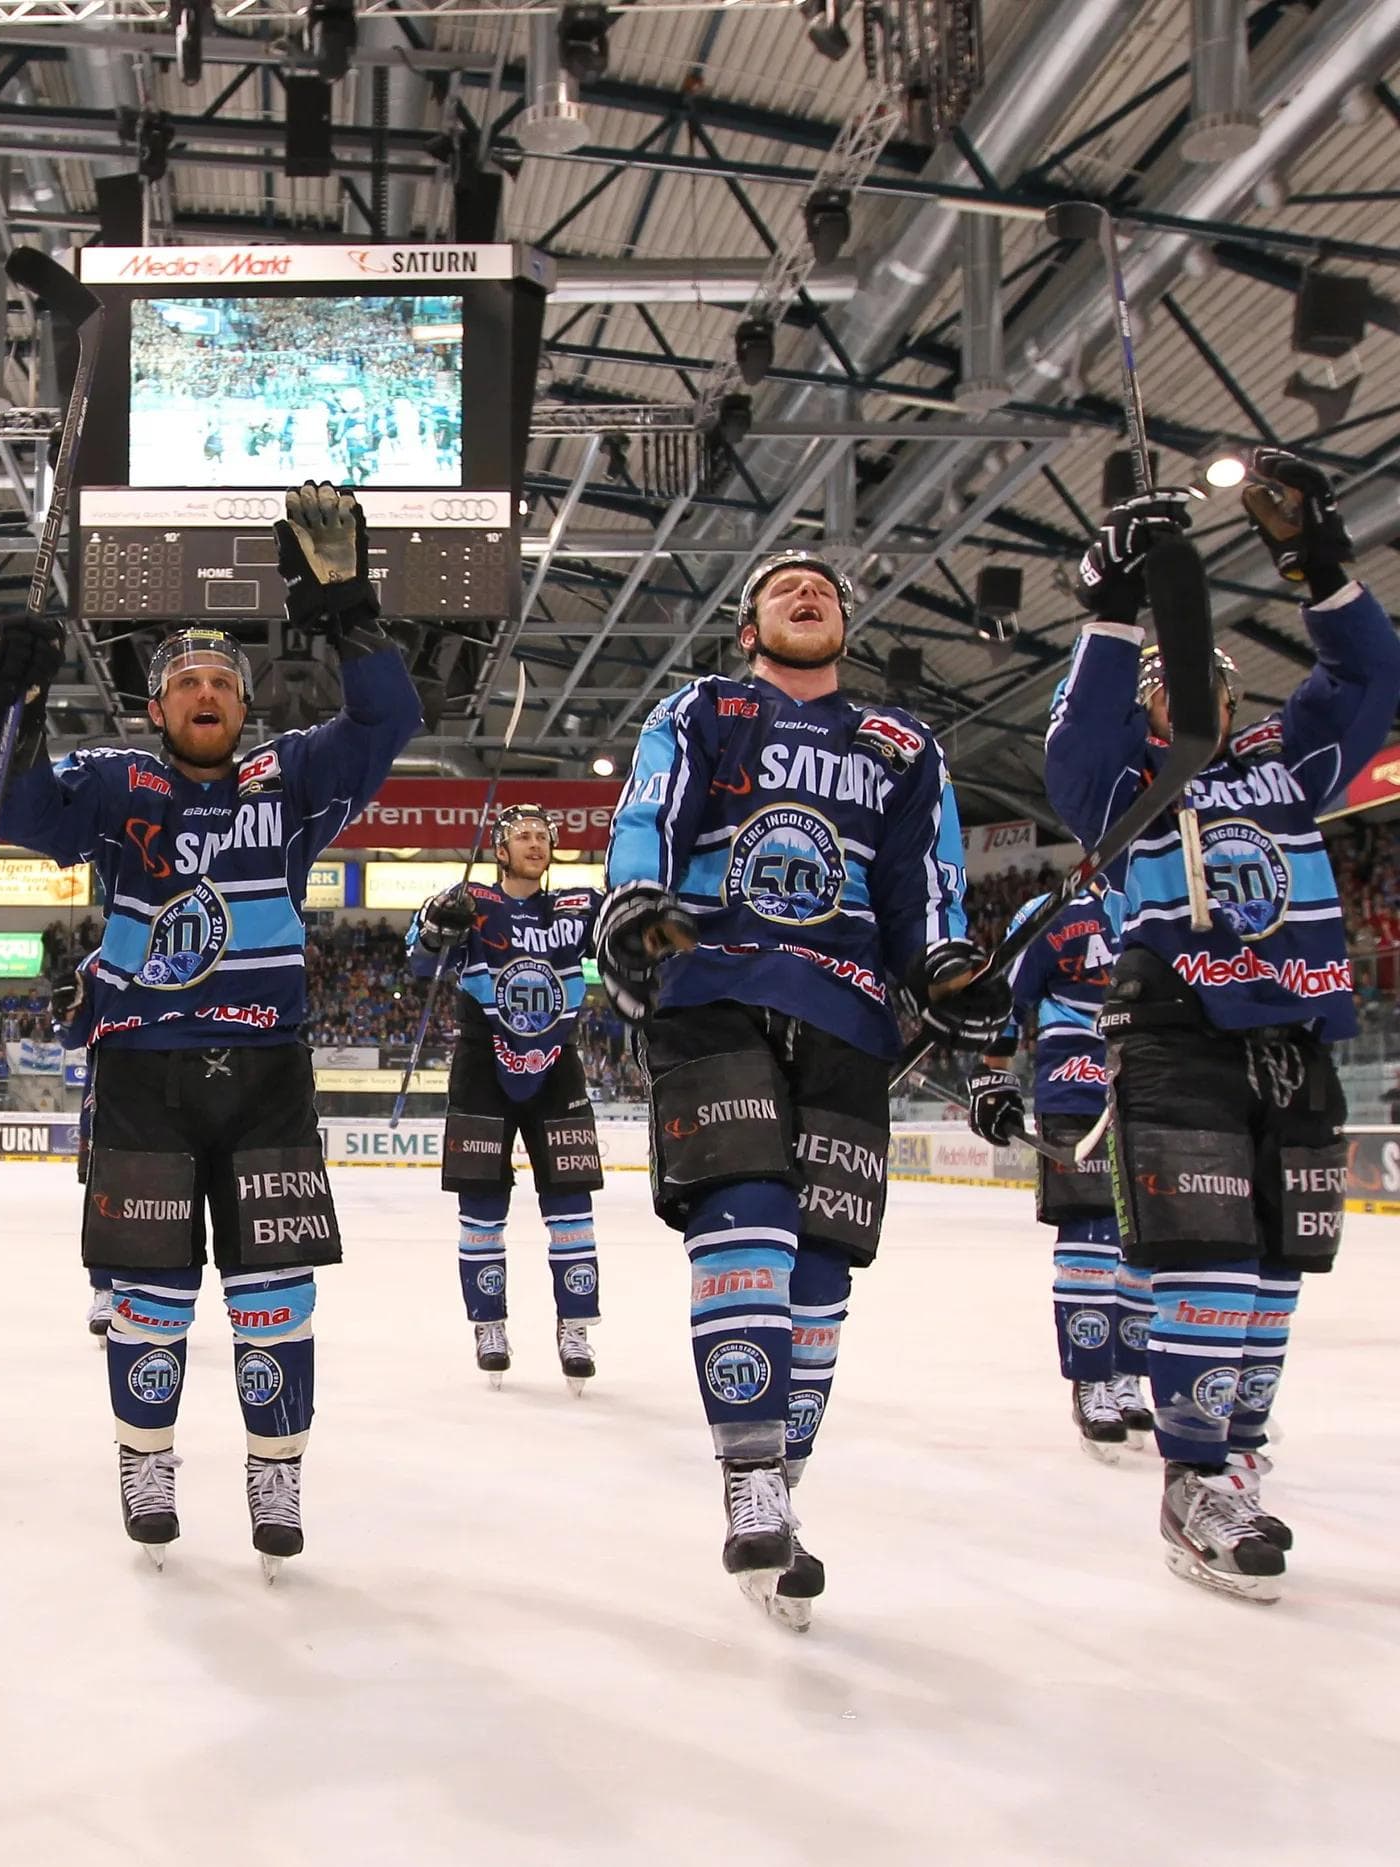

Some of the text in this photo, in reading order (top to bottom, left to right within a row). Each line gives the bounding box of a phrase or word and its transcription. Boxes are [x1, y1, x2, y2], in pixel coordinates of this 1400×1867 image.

[118, 253, 292, 277] Media Markt
[391, 250, 478, 274] SATURN
[197, 567, 234, 579] HOME
[765, 812, 834, 854] INGOLSTADT
[747, 854, 822, 899] 50
[1205, 862, 1270, 905] 50
[208, 916, 224, 951] 2014
[510, 985, 551, 1013] 50
[696, 1098, 778, 1126] SATURN
[345, 1132, 439, 1156] SIEME
[1077, 1159, 1111, 1174] SATU
[238, 1170, 328, 1201] HERRN
[1178, 1172, 1252, 1198] SATURN
[121, 1198, 192, 1221] SATURN
[253, 1214, 331, 1245] BRÄU
[141, 1370, 173, 1390] 50
[243, 1371, 270, 1390] 50
[716, 1362, 757, 1387] 50
